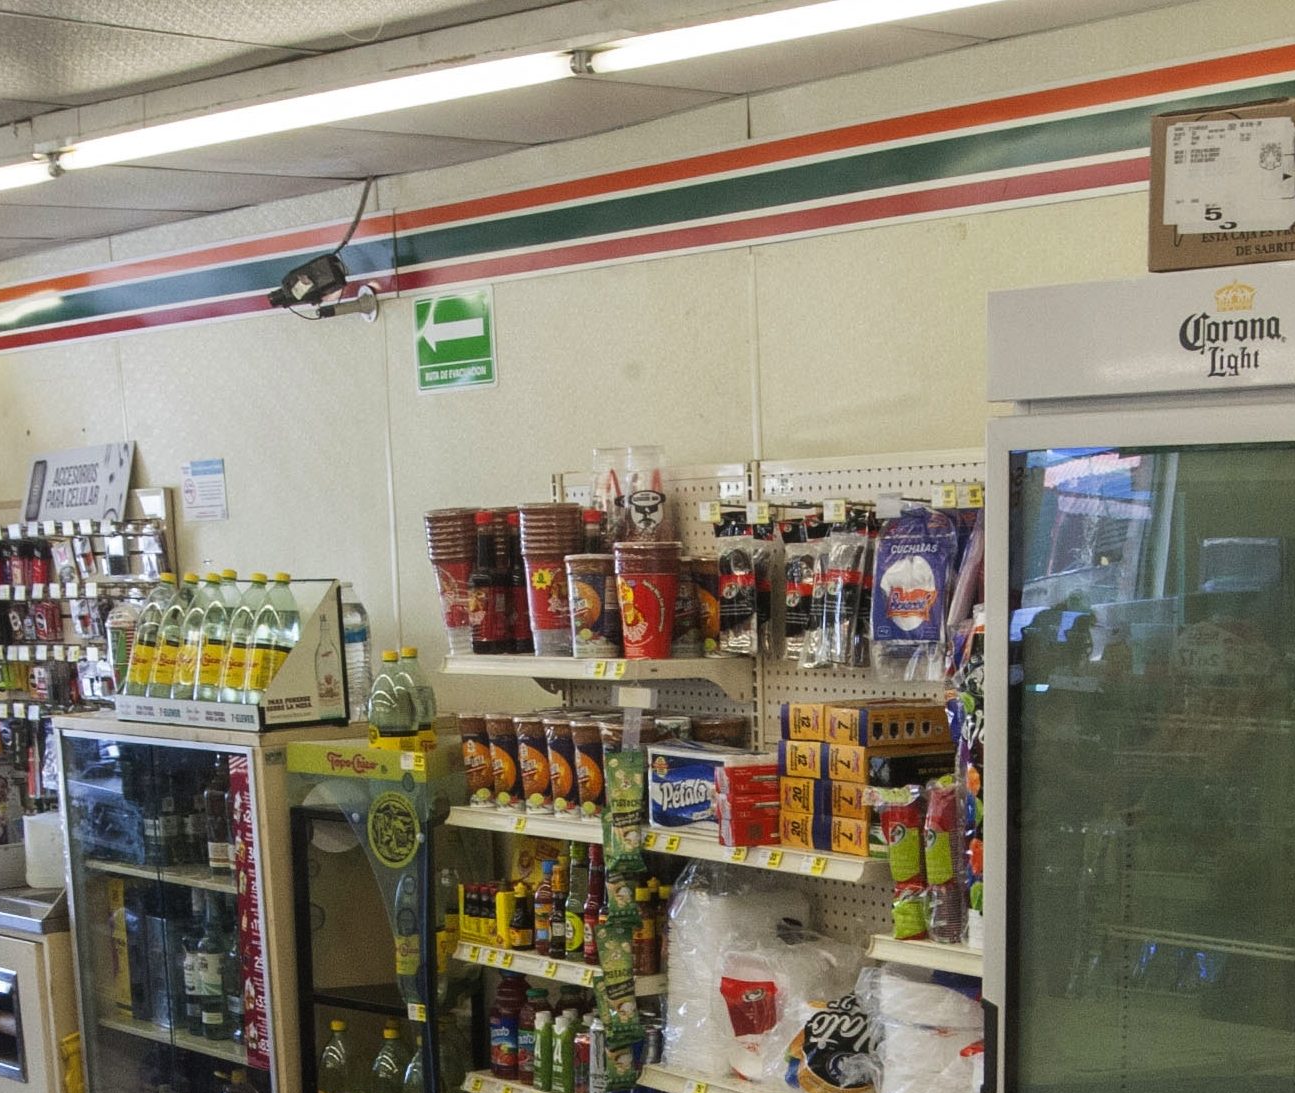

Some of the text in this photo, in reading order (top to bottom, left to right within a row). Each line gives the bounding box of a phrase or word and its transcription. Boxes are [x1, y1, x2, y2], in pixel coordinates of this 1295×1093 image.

[1235, 246, 1252, 256] DE
[1179, 312, 1282, 354] Corona
[1207, 346, 1260, 378] Light
